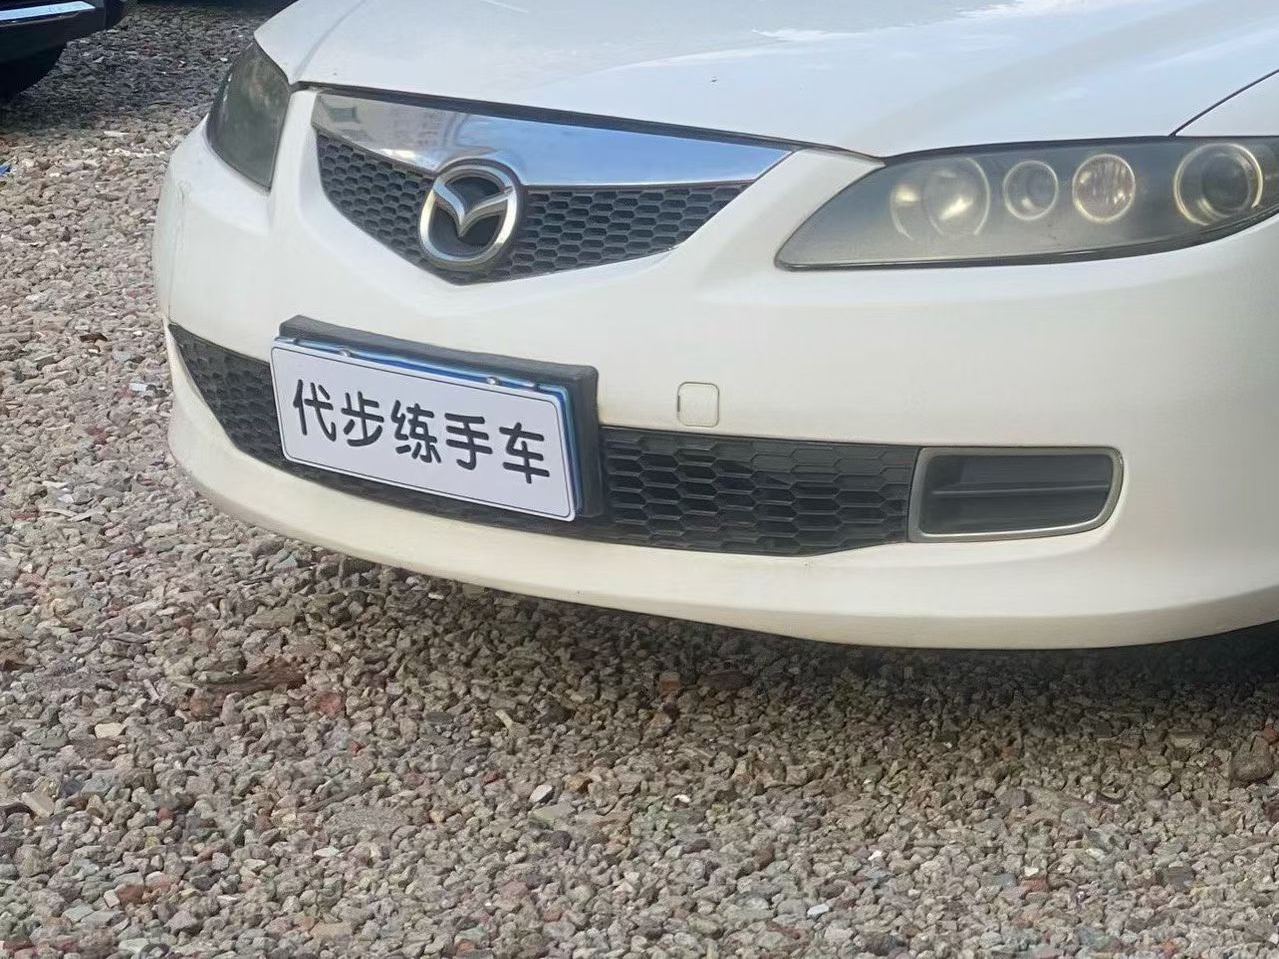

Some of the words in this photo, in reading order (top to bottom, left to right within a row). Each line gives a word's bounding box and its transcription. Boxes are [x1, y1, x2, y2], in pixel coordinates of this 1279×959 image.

[293, 378, 550, 484] 代步练手车
